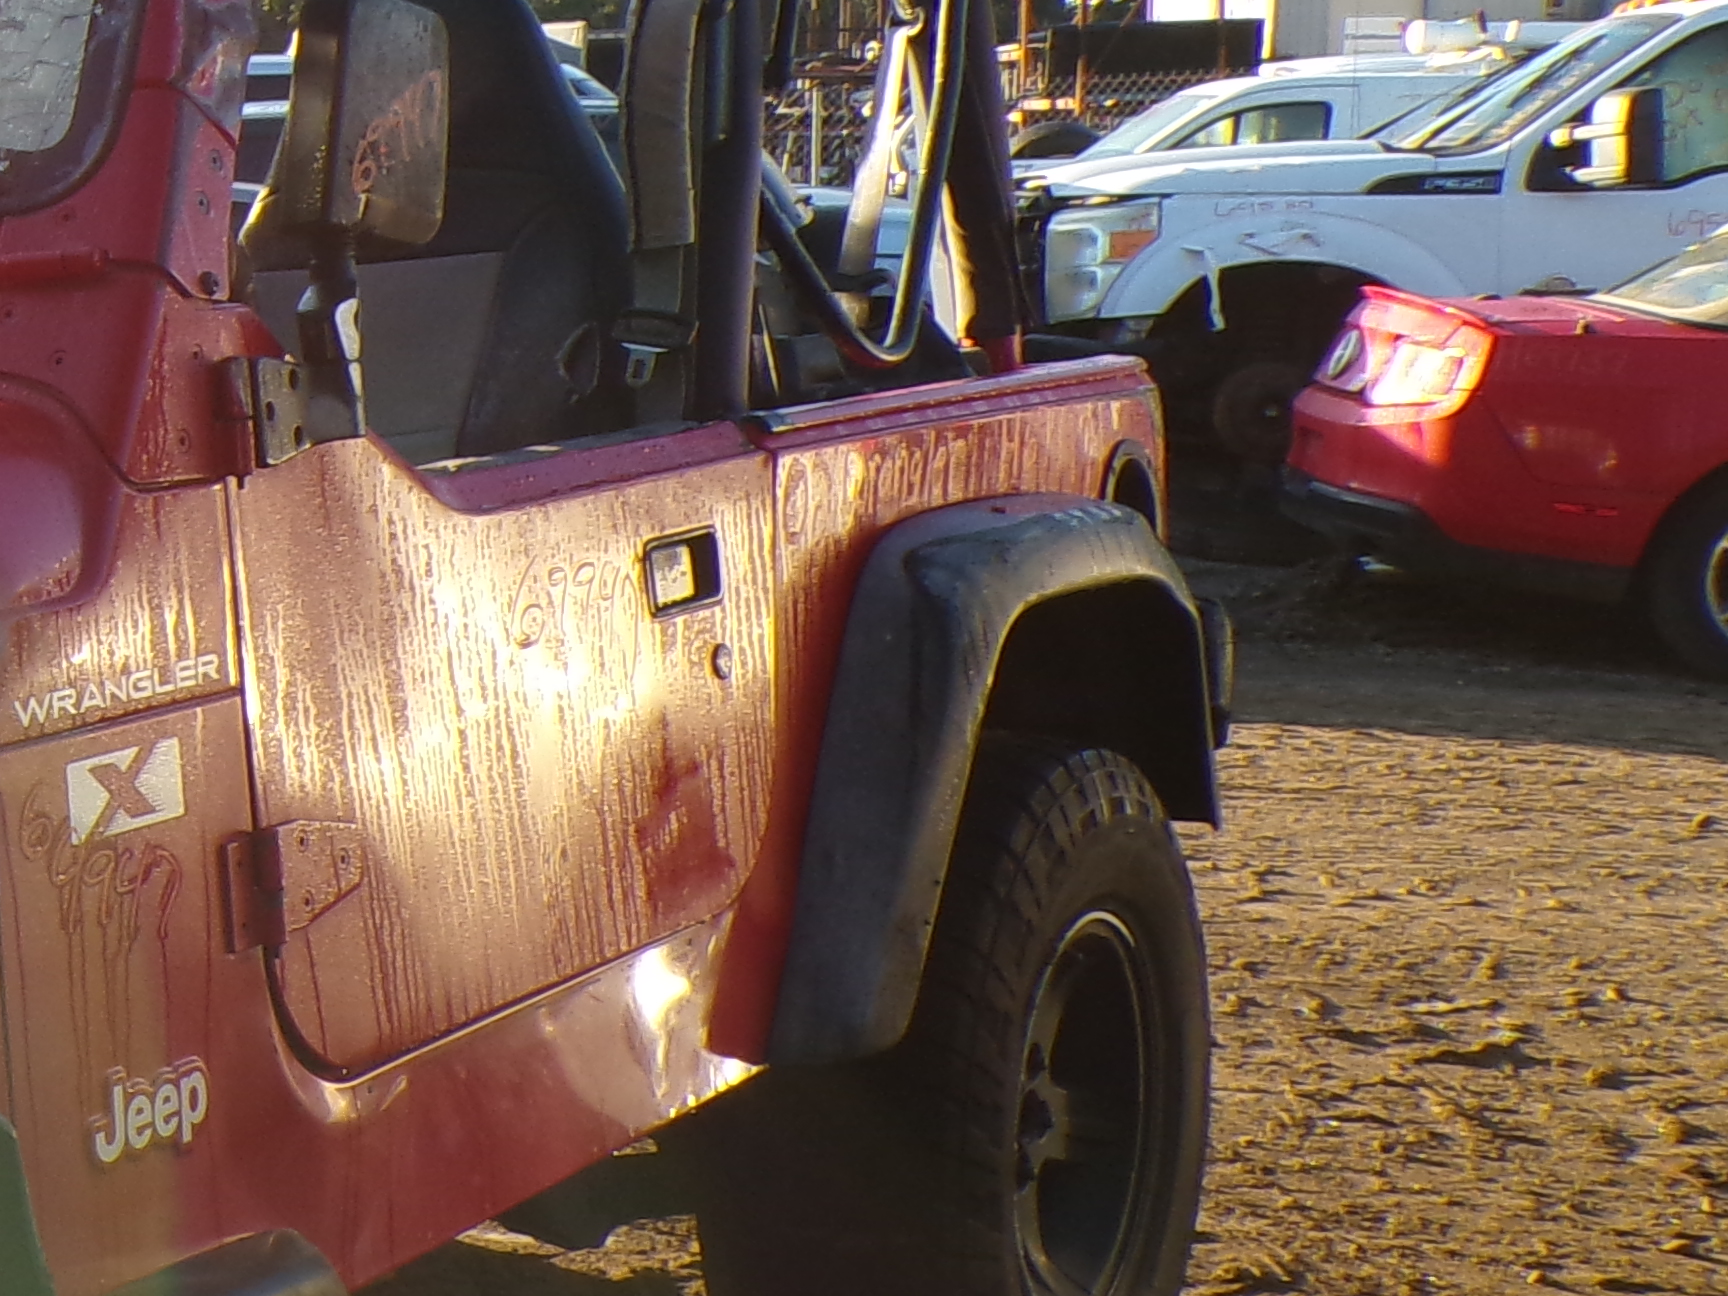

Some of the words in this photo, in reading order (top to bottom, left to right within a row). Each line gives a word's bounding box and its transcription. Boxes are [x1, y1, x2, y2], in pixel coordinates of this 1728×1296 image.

[13, 653, 222, 728] WRANGLER
[74, 736, 178, 846] X
[93, 1064, 211, 1164] Jeep
